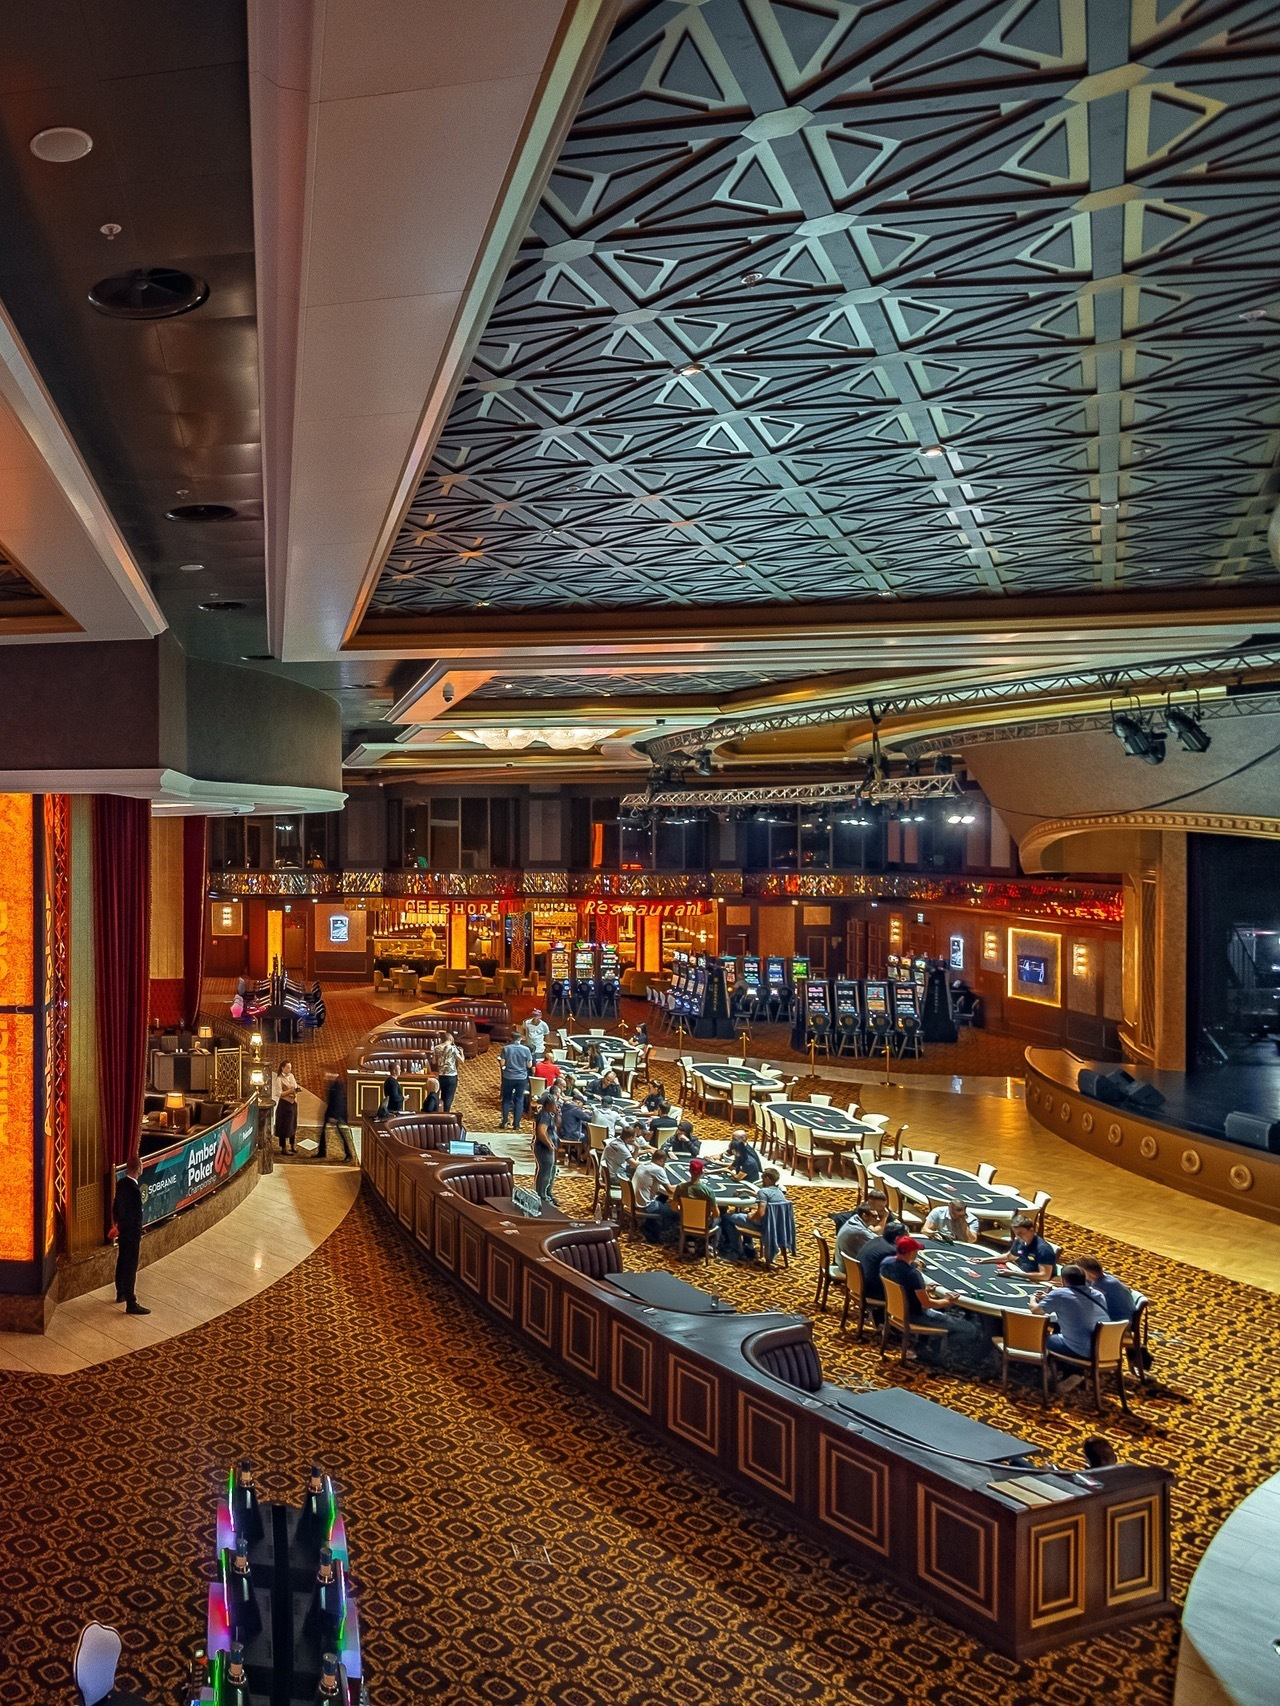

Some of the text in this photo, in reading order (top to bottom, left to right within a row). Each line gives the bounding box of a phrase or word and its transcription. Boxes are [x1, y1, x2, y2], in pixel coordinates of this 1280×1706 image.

[584, 899, 703, 917] Restaurant
[188, 1141, 217, 1168] Amber
[148, 1174, 177, 1195] SOBRANIE
[188, 1161, 214, 1186] Poker
